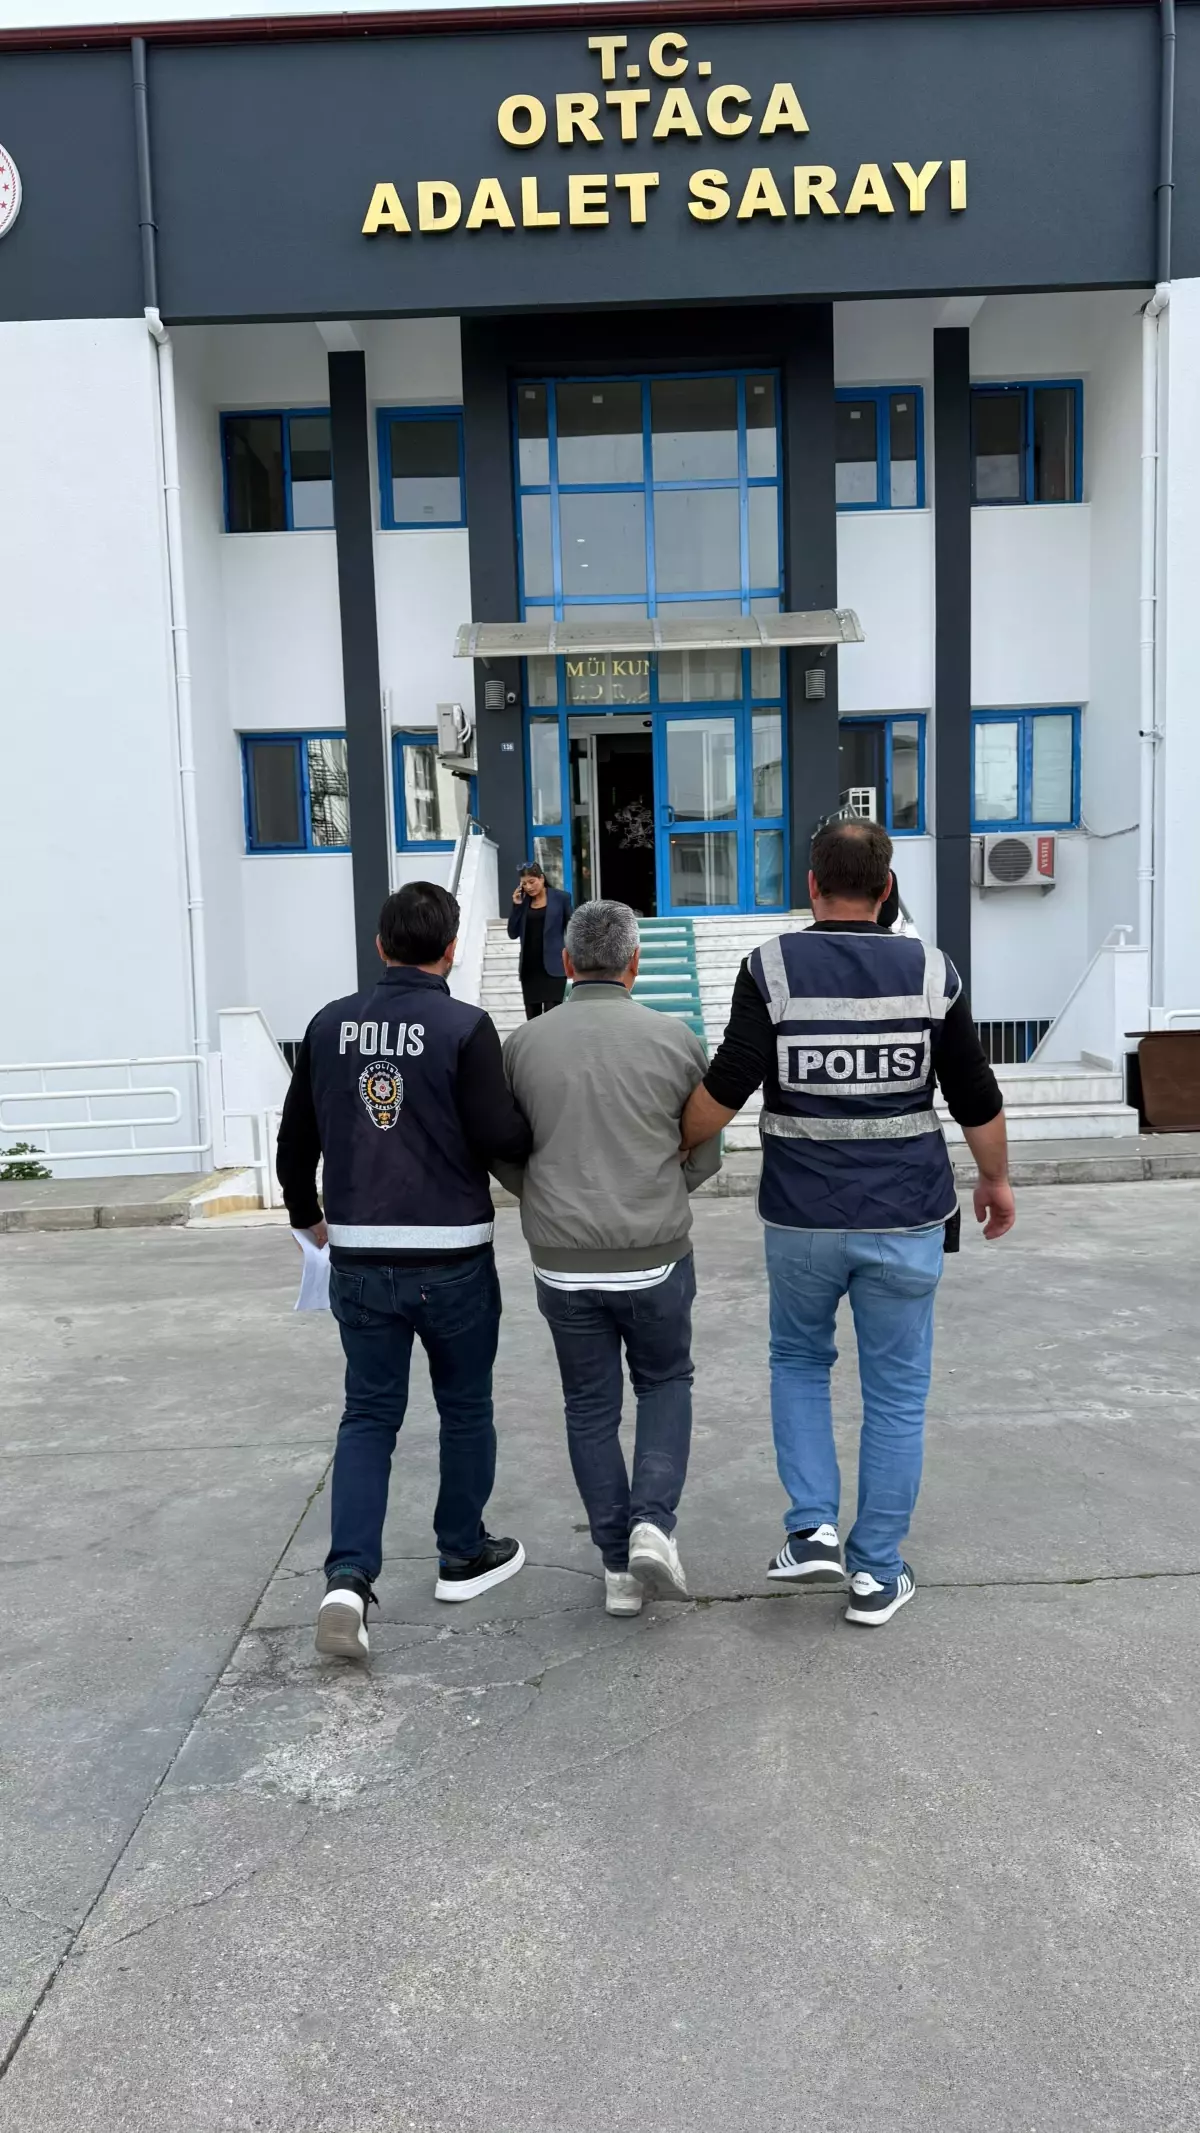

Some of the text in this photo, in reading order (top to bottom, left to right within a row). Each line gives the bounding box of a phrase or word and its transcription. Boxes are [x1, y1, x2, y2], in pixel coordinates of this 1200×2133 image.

[588, 32, 711, 80] T.C.
[497, 83, 809, 147] ORTACA
[361, 160, 967, 234] ADALET SARAYI
[1041, 841, 1049, 868] VESTEL
